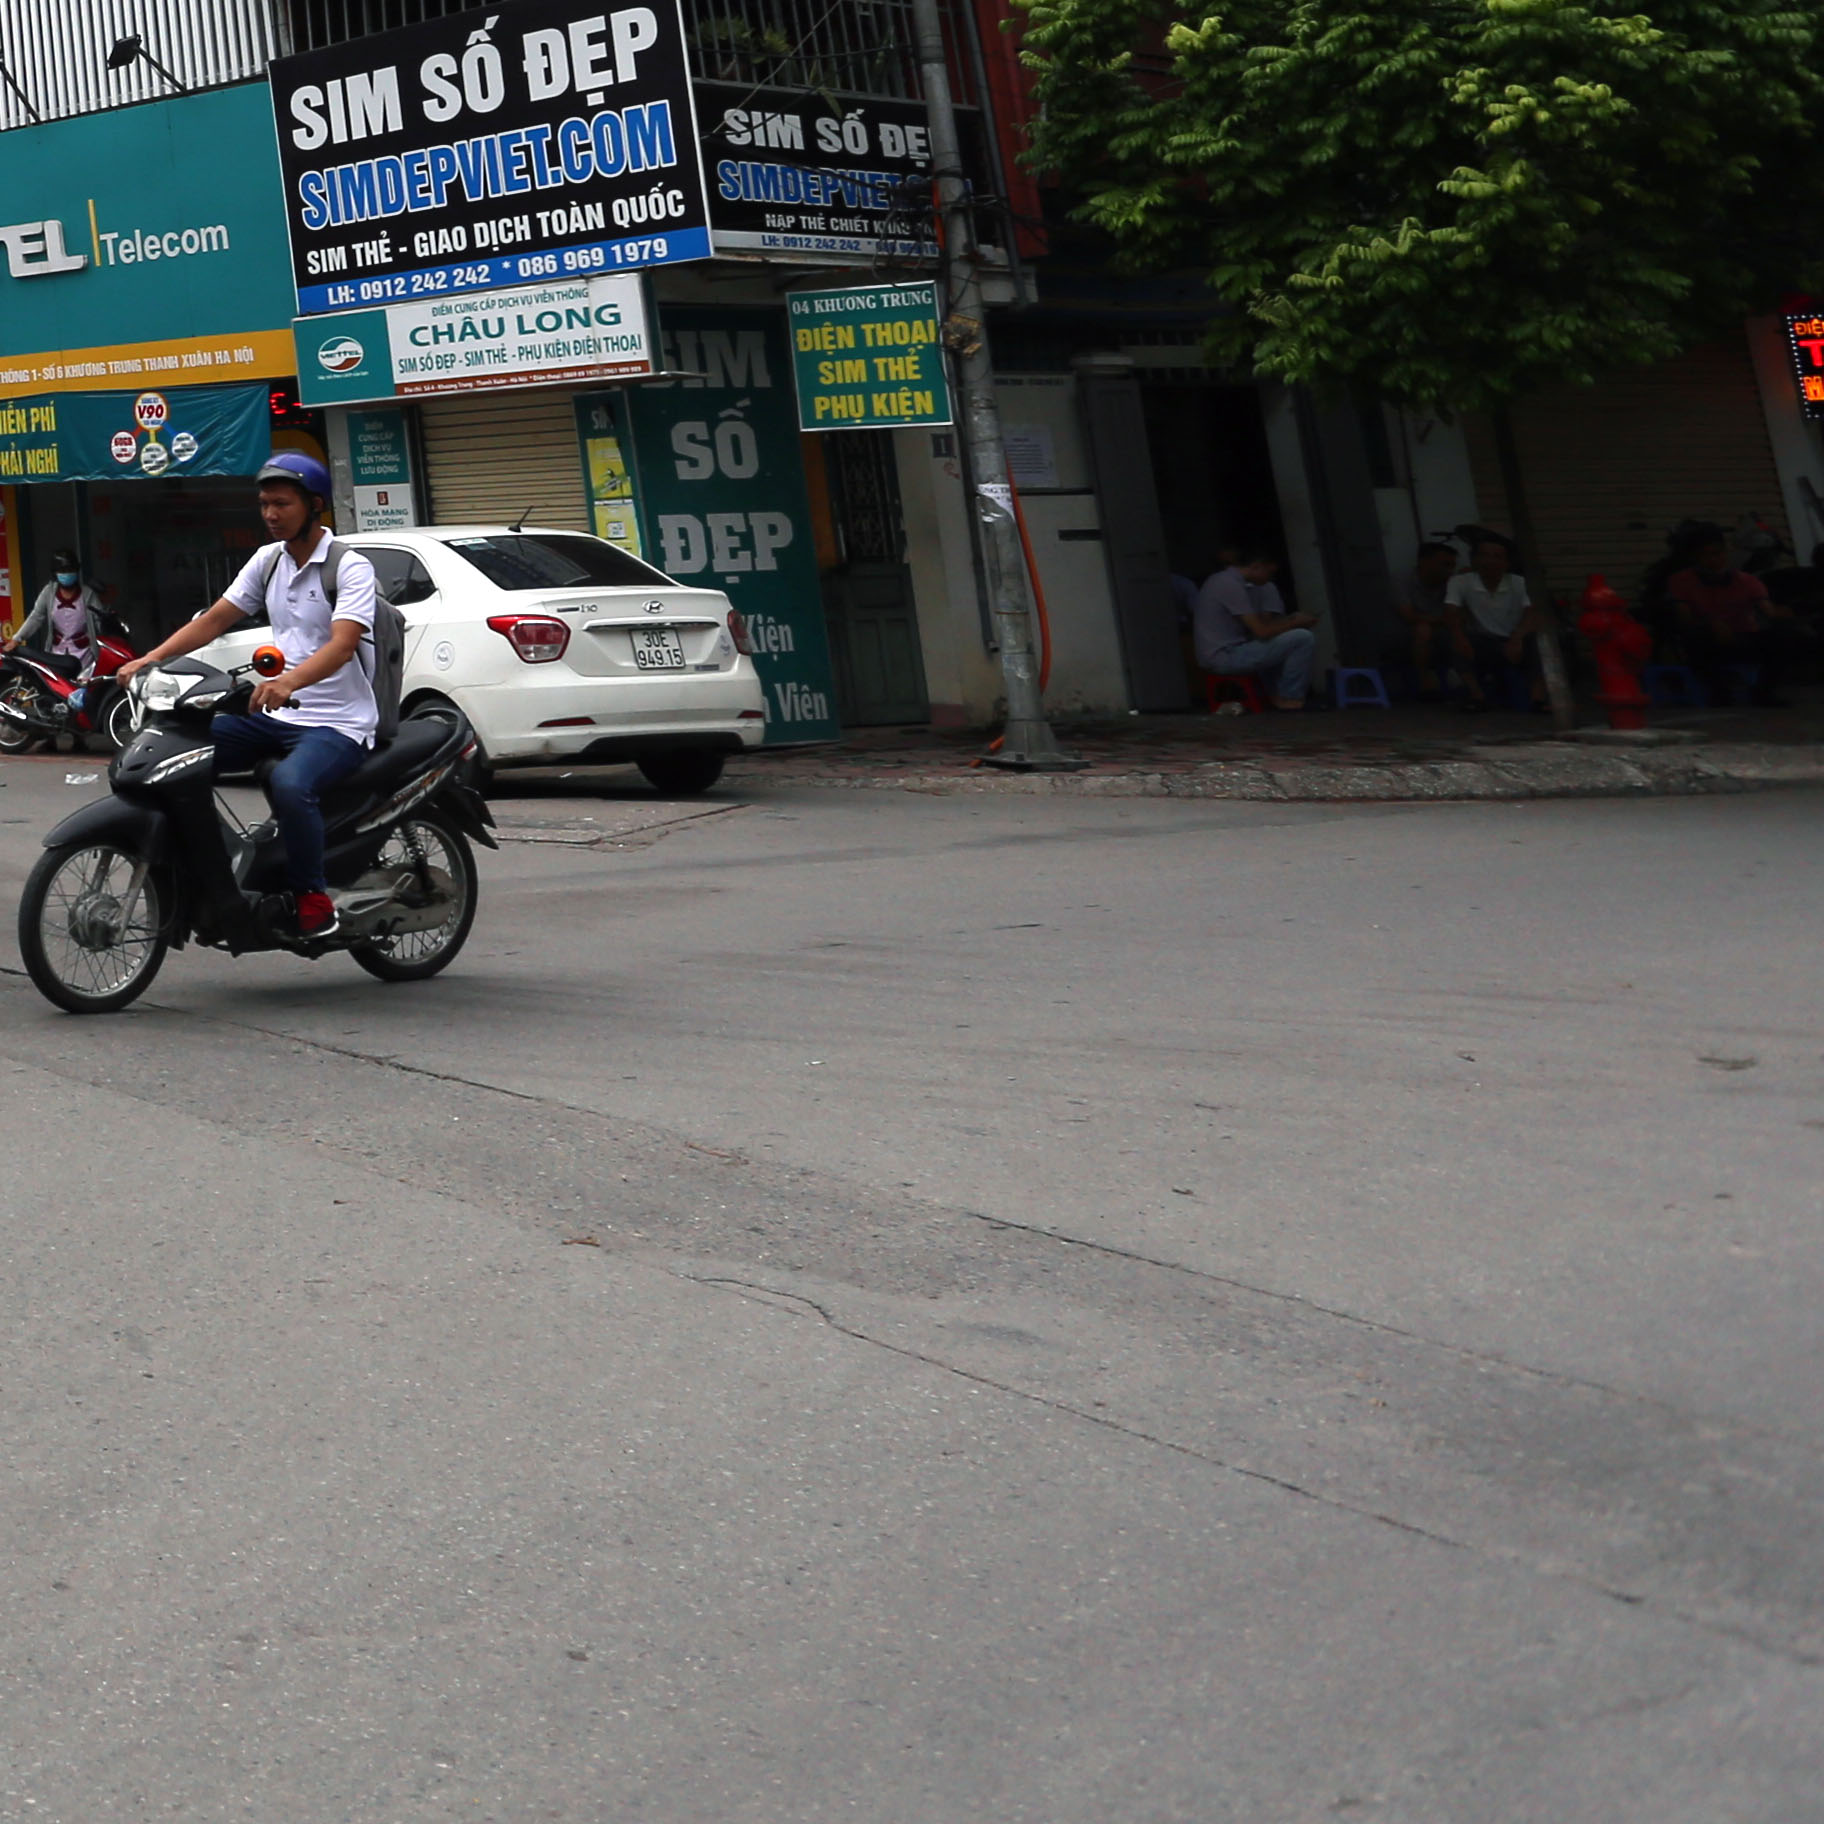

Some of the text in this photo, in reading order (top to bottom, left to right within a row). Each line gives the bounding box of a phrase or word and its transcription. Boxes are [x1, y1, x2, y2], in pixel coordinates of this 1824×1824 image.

[290, 7, 658, 151] SIM SỐ ĐẸP
[724, 108, 870, 155] SIM SỐ
[299, 99, 677, 231] SIMDEPVIET.COM
[99, 224, 230, 267] Telecom
[306, 182, 685, 276] SIM THẺ GIAO DỊCH TOÀN QUỐC
[783, 236, 861, 251] 0912 242 242
[326, 238, 668, 306] LH: 0912 242 242 086 969 1979
[792, 290, 932, 314] 04 KHƯƠNG TRUNG
[409, 303, 622, 347] CHÂU LONG
[796, 319, 936, 356] ĐIỆN THOẠI
[109, 359, 142, 375] TRUNG
[143, 356, 179, 372] THANH
[398, 357, 418, 374] SIM
[419, 351, 434, 372] SỐ
[435, 353, 457, 374] ĐẸP
[464, 350, 483, 367] SIM
[545, 339, 572, 363] KIỆN
[601, 334, 642, 356] THOẠI
[818, 347, 923, 386] SIM THẺ
[30, 400, 56, 433] PHÍ
[138, 404, 164, 419] V90
[814, 386, 935, 424] PHỤ KIỆN
[670, 397, 759, 480] SỐ
[25, 443, 59, 474] NGHĨ
[657, 511, 793, 584] ĐẸP
[638, 650, 682, 667] 949.15
[644, 630, 669, 648] 30E
[774, 682, 829, 723] Viên
